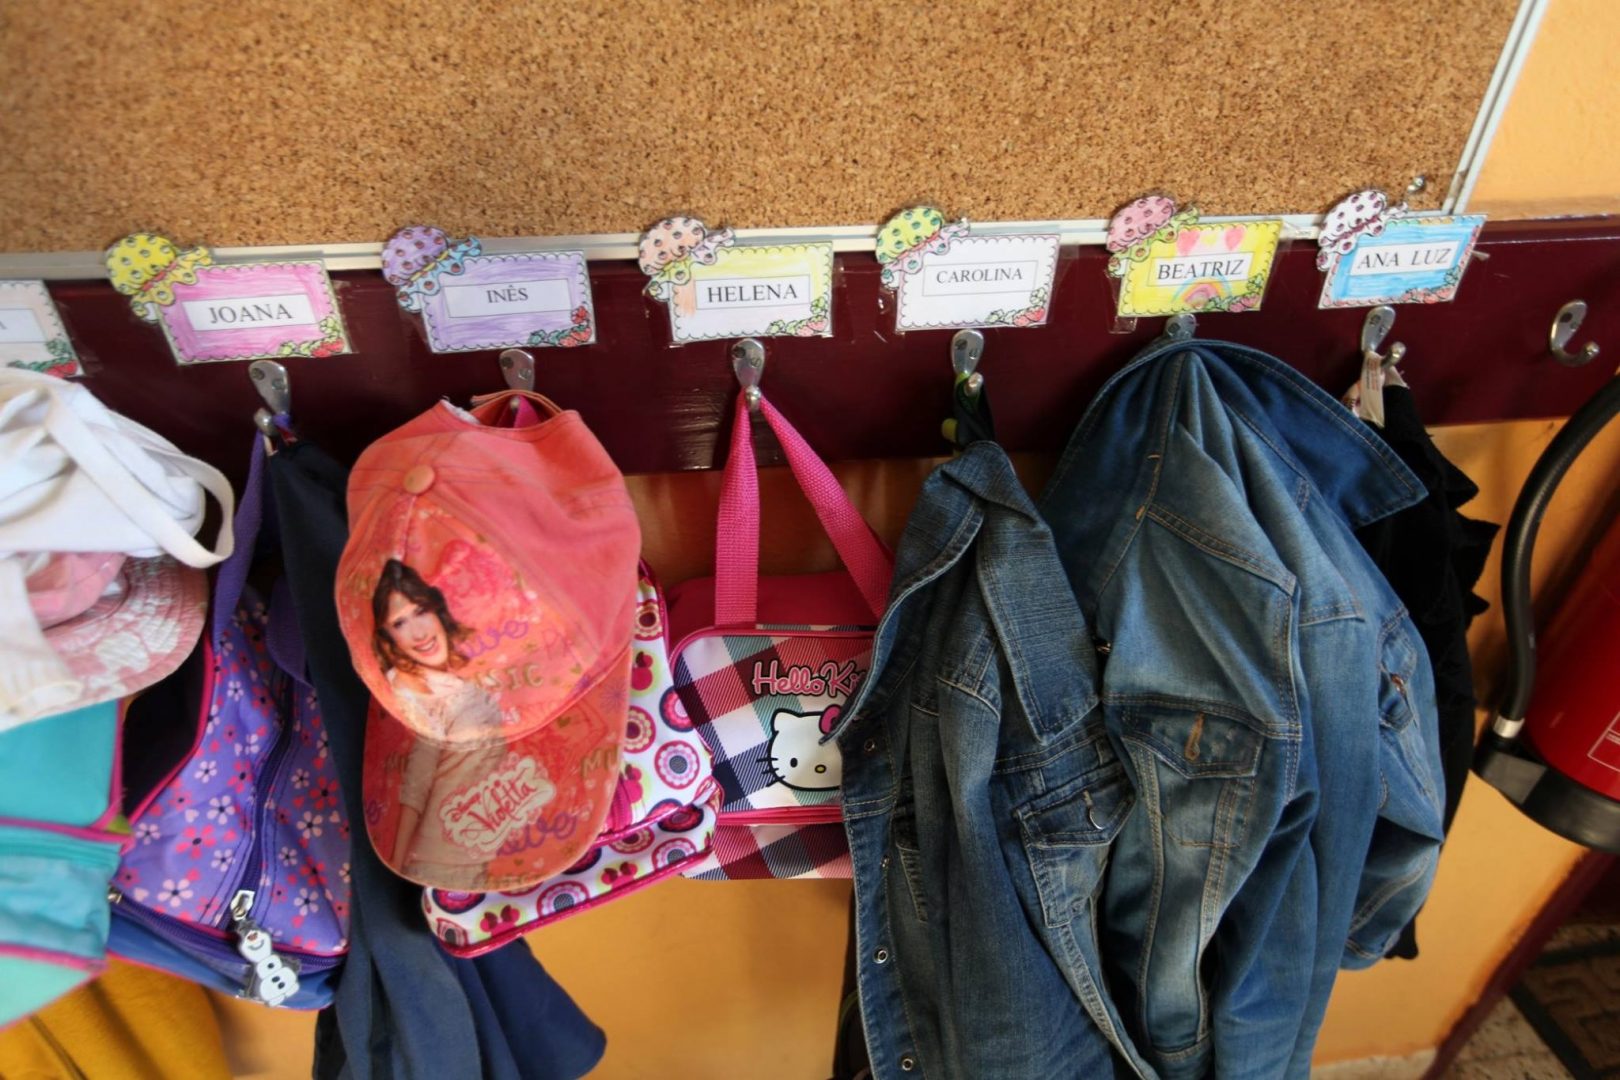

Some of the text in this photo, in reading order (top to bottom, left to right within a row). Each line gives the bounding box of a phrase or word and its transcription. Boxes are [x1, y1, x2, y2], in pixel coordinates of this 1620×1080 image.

[1157, 258, 1245, 280] BEATRIZ
[1356, 247, 1453, 270] ANA LUZ
[935, 266, 1024, 284] CAROLINA
[486, 284, 529, 304] INÊS
[707, 284, 798, 304] HELENA
[208, 303, 293, 324] JOANA
[752, 660, 864, 697] Hello Ki
[457, 768, 549, 845] Violetta
